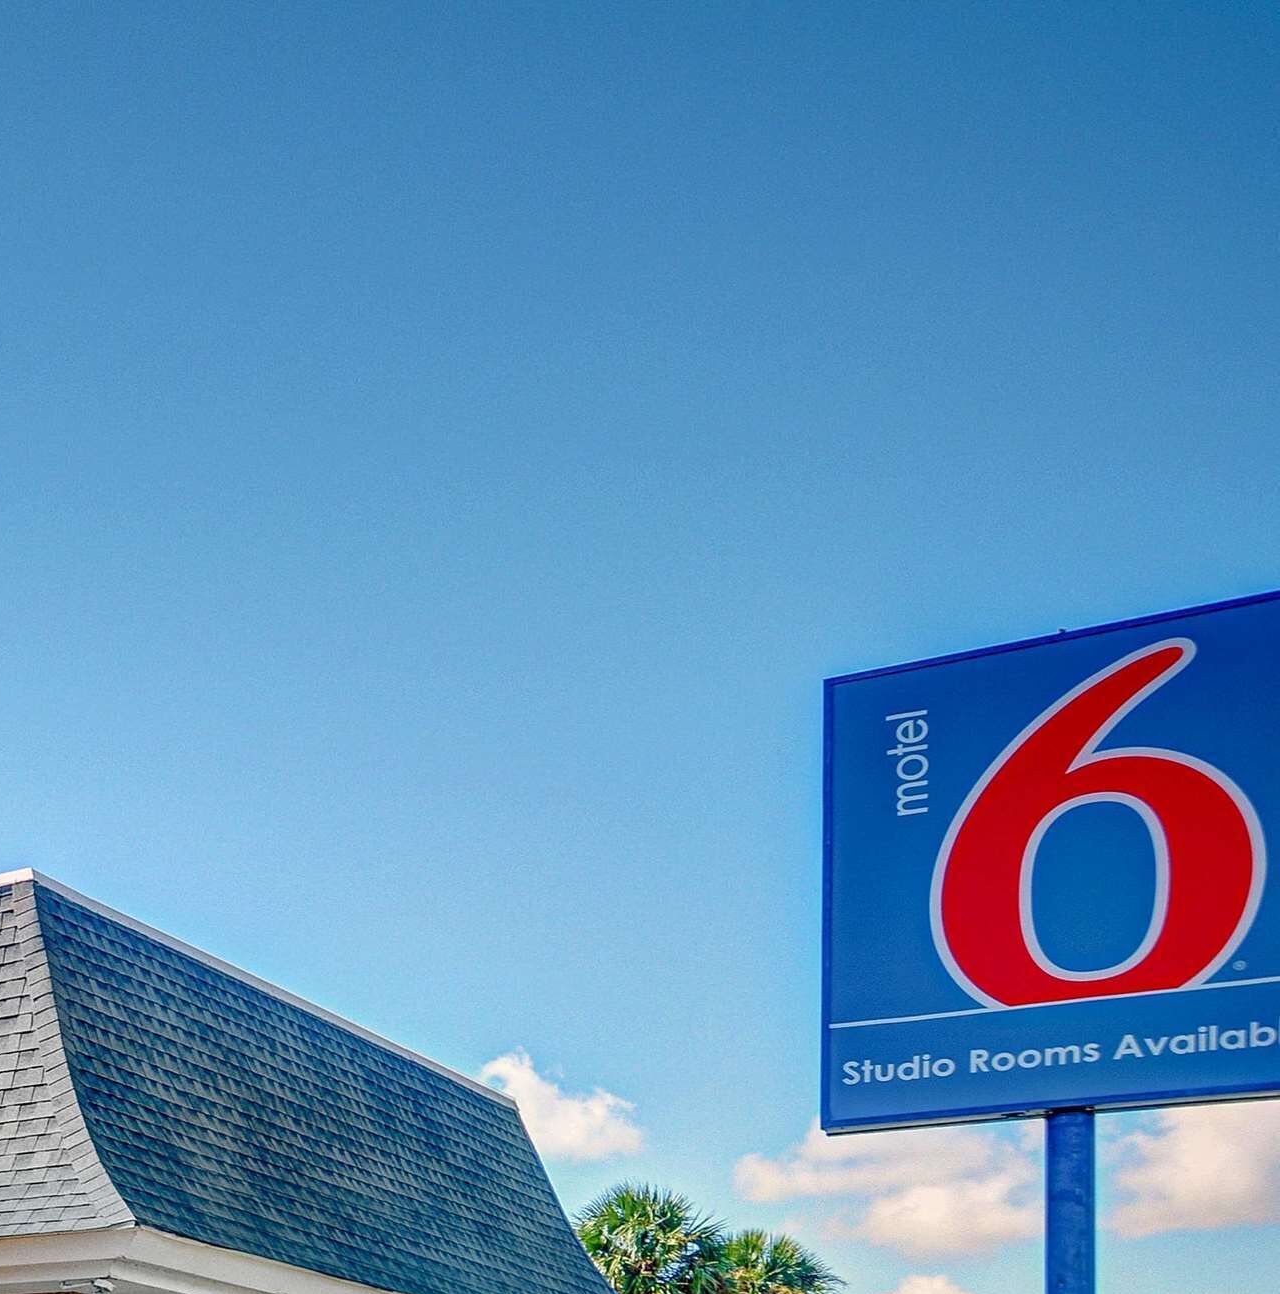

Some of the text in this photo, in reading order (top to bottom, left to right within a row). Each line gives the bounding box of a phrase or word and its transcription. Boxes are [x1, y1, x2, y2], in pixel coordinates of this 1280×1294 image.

[885, 637, 1267, 1010] motel 6
[842, 1015, 1280, 1086] Studio Rooms Availab
